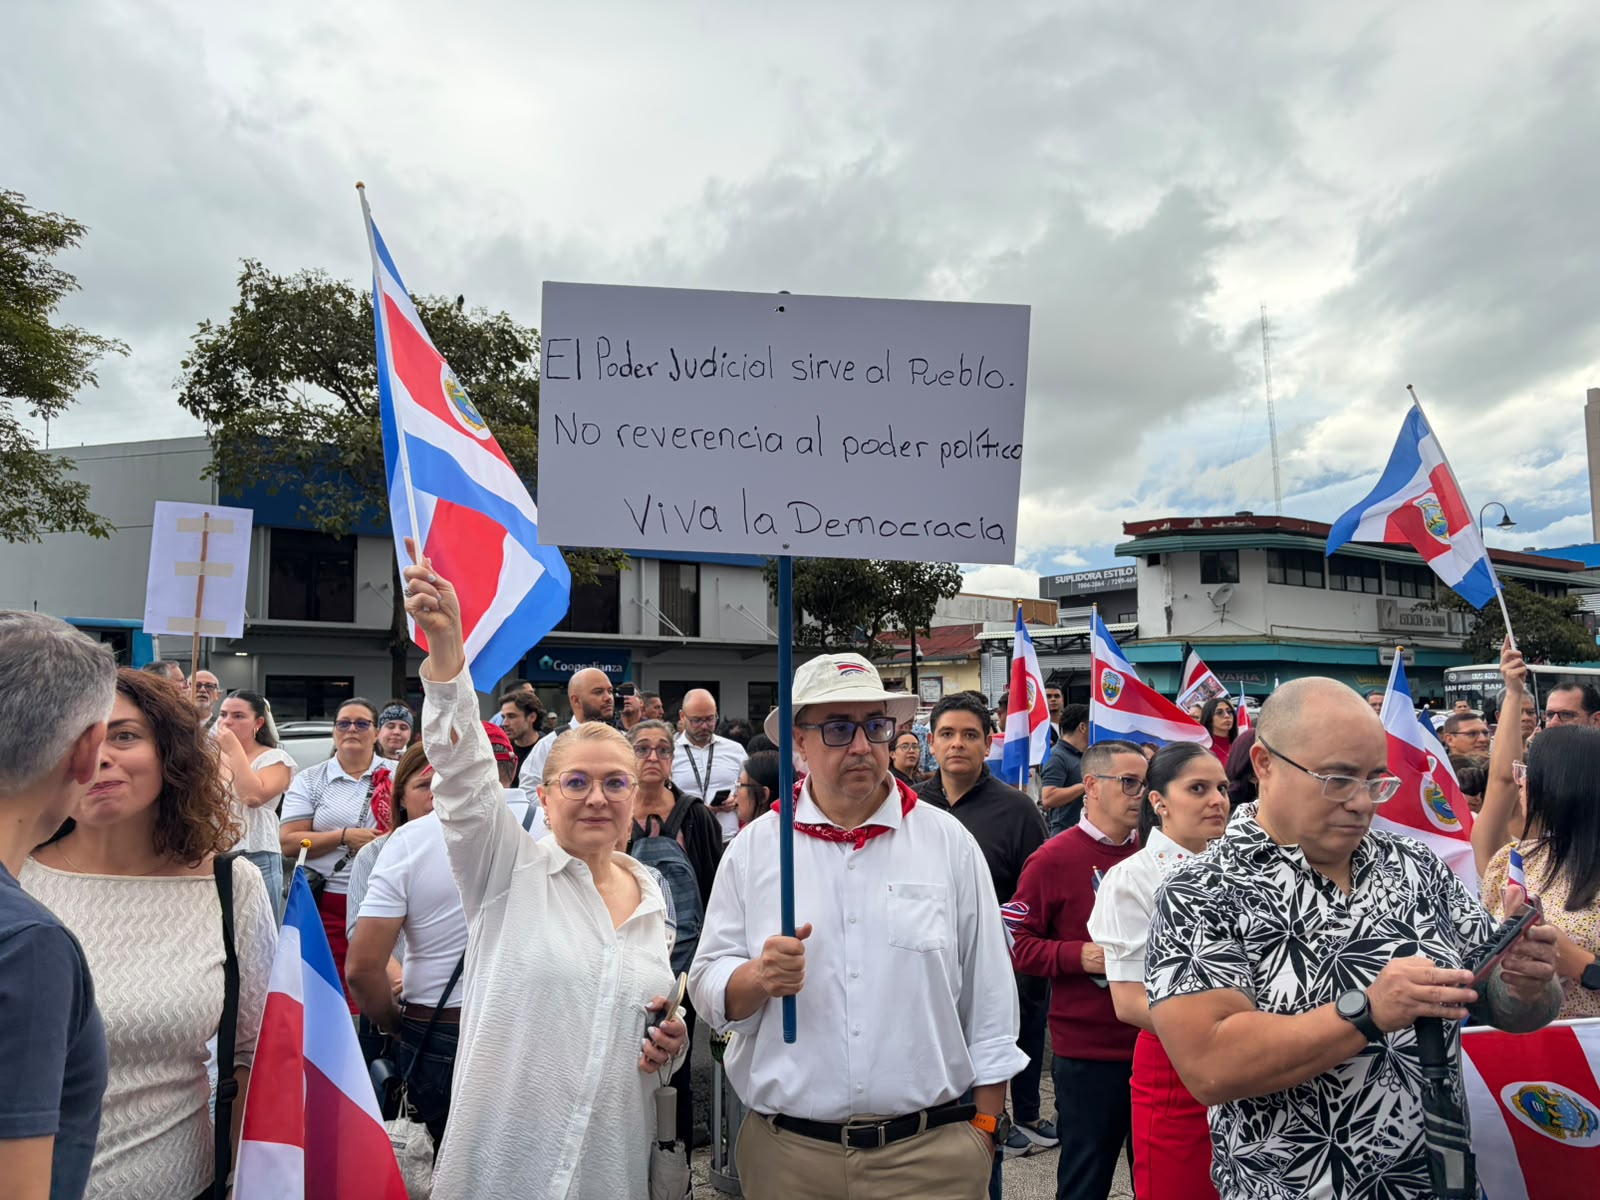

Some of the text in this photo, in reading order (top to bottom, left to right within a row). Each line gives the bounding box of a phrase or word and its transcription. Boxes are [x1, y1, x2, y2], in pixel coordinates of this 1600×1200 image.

[545, 335, 1016, 390] El Poder Judicial sirve al Pueblo.
[554, 411, 1023, 469] No reverencia al poder político
[623, 487, 1006, 545] Viva la Democracia
[1055, 571, 1102, 584] SUPLIDORA
[1103, 567, 1133, 579] ESTILO
[1218, 672, 1261, 681] VARIA
